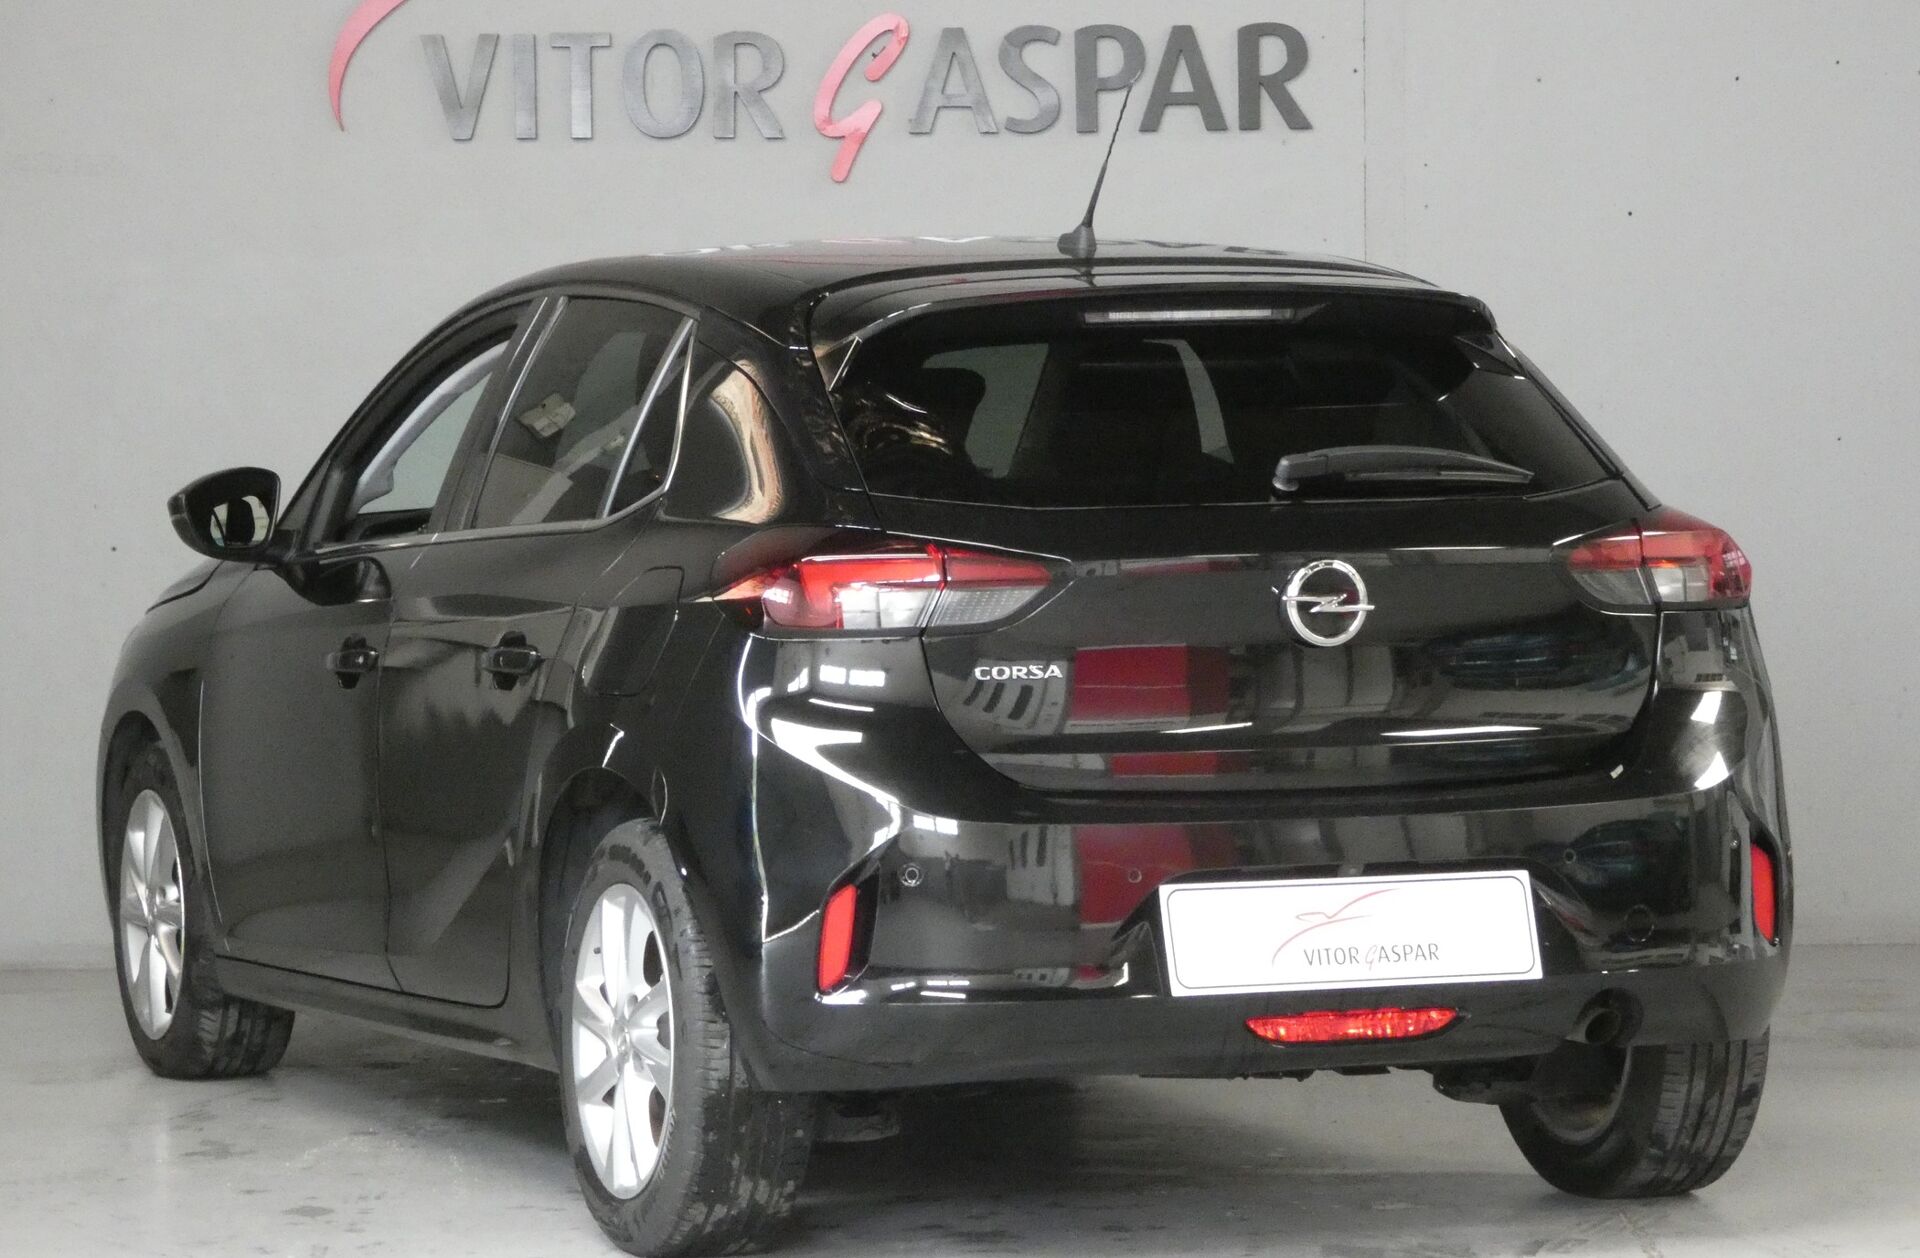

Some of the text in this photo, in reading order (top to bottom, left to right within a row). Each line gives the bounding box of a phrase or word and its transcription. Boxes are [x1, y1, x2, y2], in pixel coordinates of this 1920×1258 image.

[420, 13, 1313, 183] VITOR GASPAR
[974, 664, 1063, 681] CORSA
[1304, 943, 1440, 971] VITOR GASPAR
